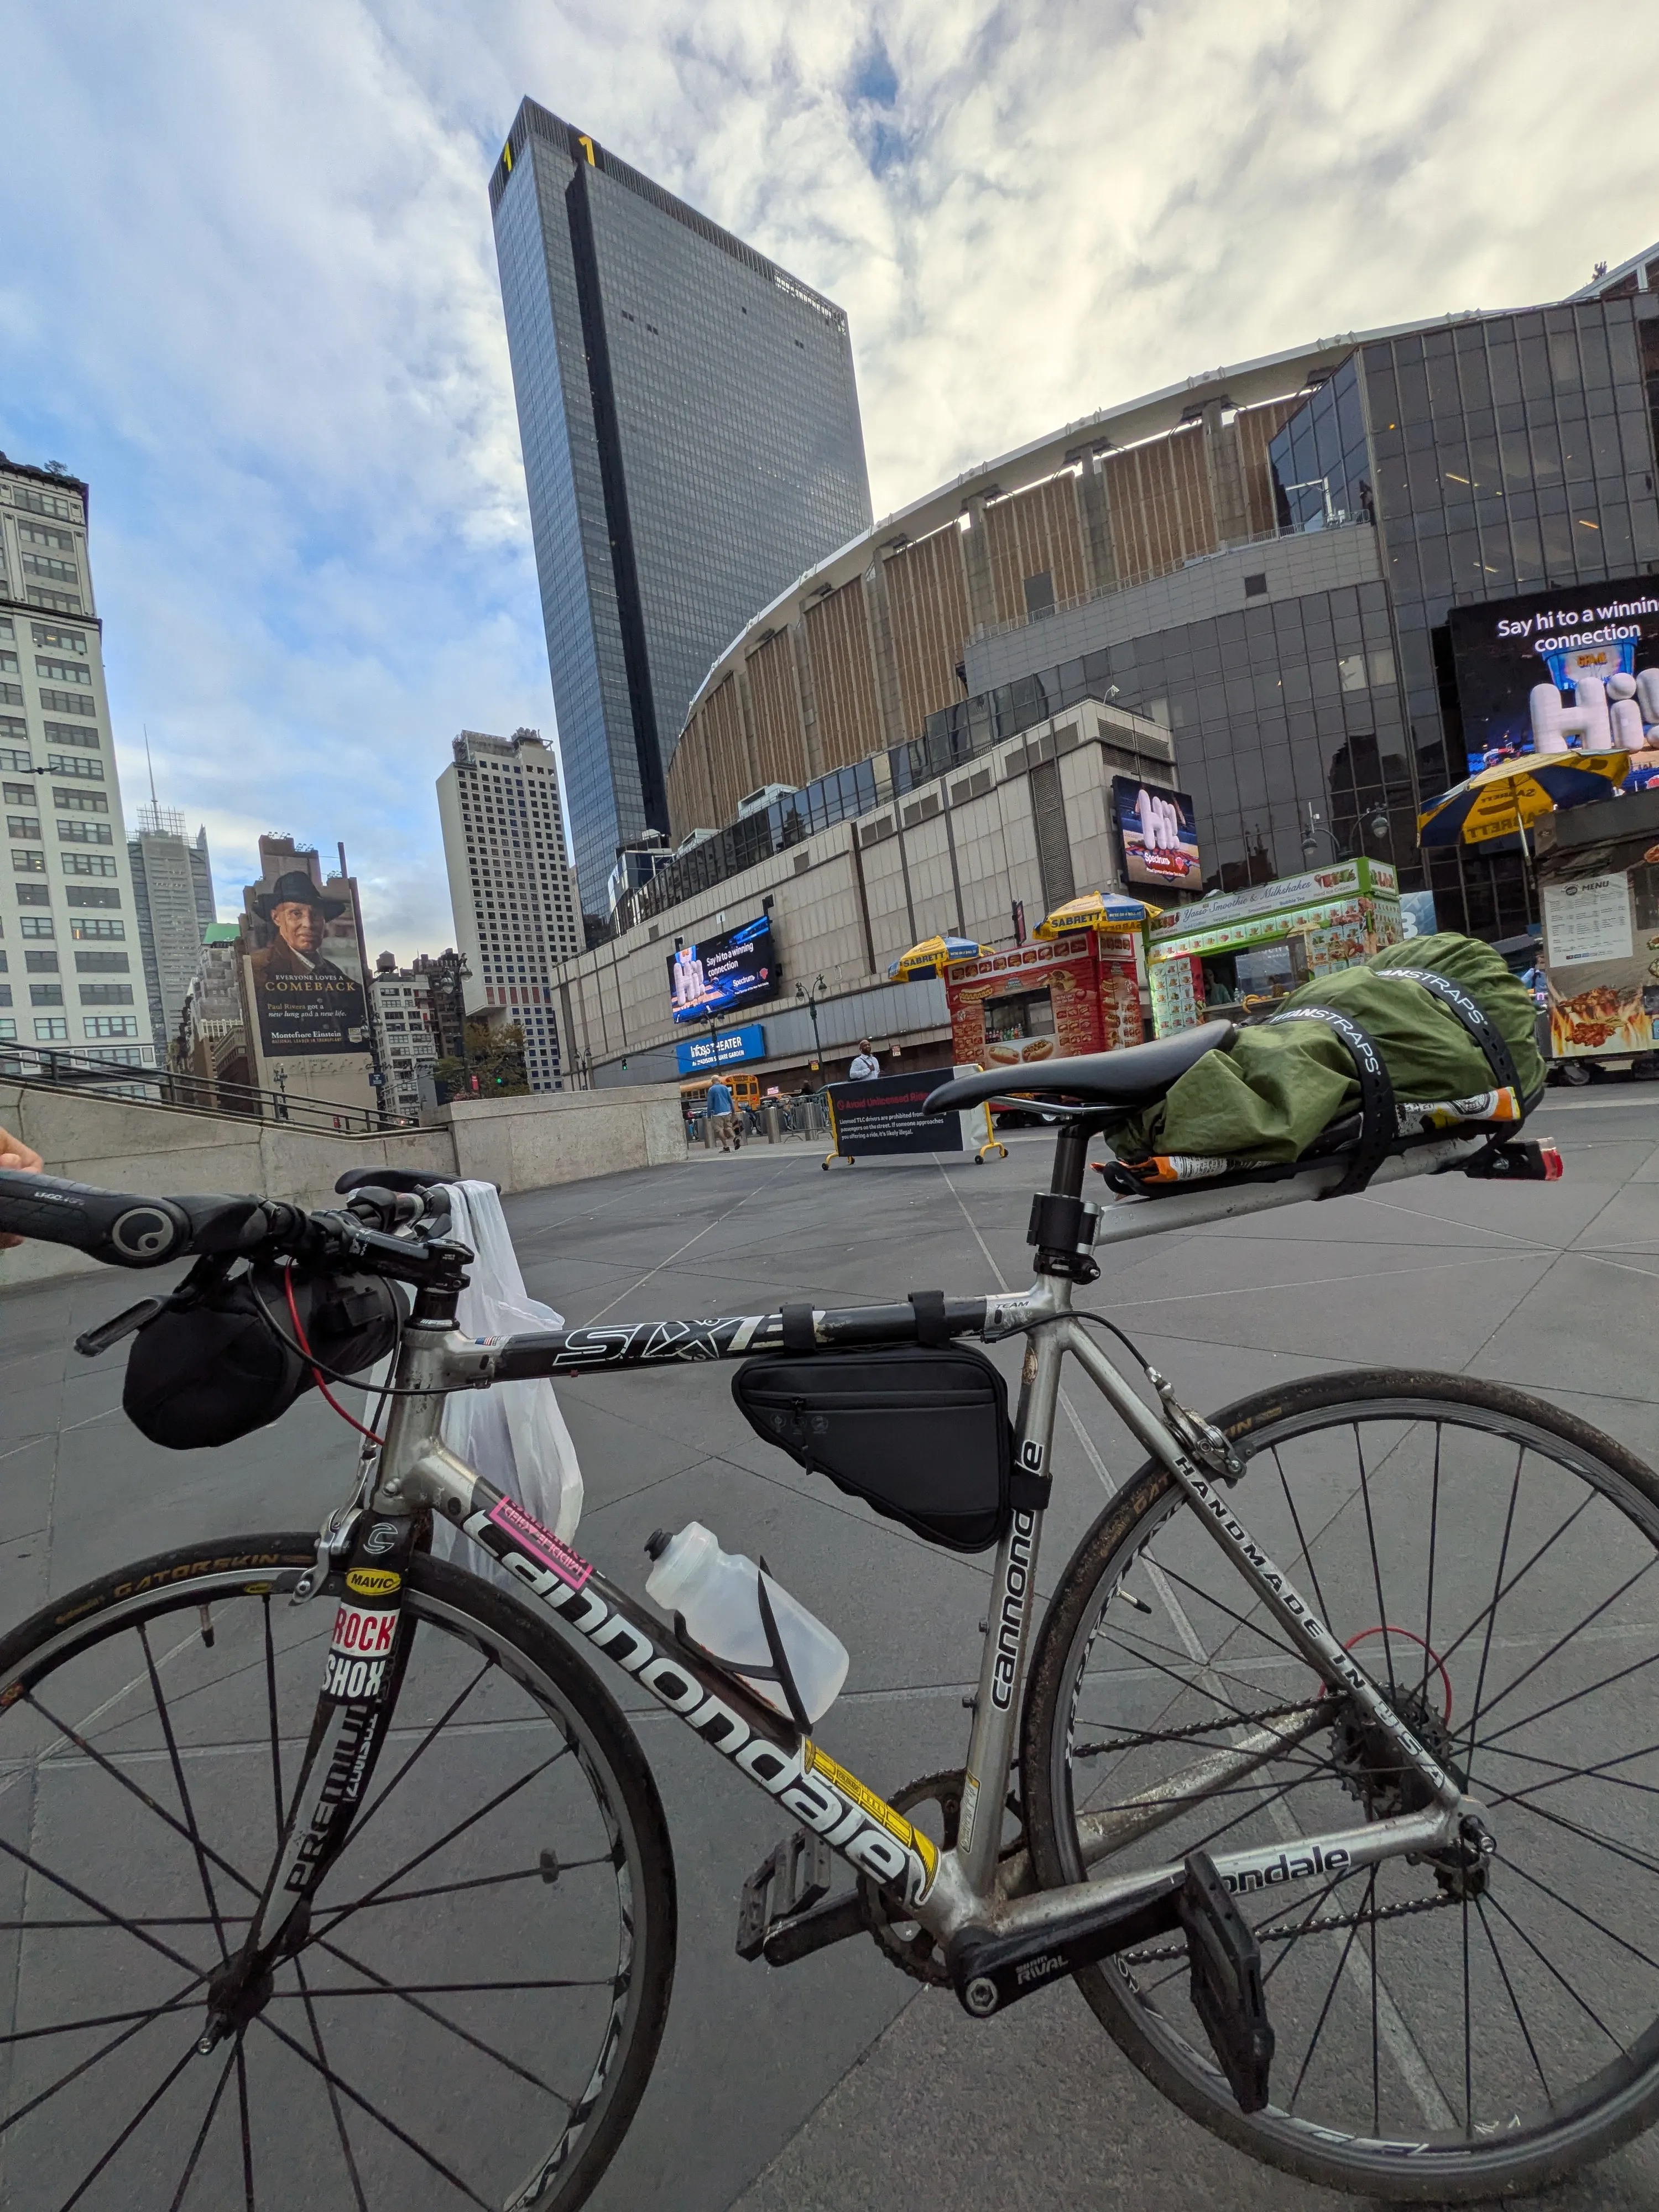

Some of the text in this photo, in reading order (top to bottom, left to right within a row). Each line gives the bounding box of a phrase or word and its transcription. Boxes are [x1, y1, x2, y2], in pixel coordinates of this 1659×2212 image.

[578, 136, 595, 168] 1
[1498, 596, 1659, 637] Say hi to a winnin
[1535, 623, 1641, 653] connection
[1144, 852, 1170, 865] Spectrum
[1582, 880, 1610, 891] MENU
[1183, 908, 1207, 922] Yasso
[1209, 895, 1248, 912] Smoothie
[1260, 880, 1312, 900] Milkshakes
[1051, 912, 1100, 929] SABRETT
[706, 957, 717, 967] Say
[716, 954, 722, 963] hi
[721, 952, 728, 962] to
[731, 942, 754, 957] winning
[903, 951, 945, 967] SABRETT
[708, 959, 739, 977] connection
[265, 981, 356, 992] COMEBACK
[733, 974, 755, 988] Spectrum
[1376, 969, 1488, 1025] ANSTRAPS
[690, 1043, 711, 1058] Infosys
[697, 1056, 714, 1066] MADISON
[714, 1054, 729, 1062] SUARE
[728, 1049, 745, 1059] GARDEN
[845, 1099, 866, 1109] Avoid
[867, 1093, 910, 1105] Unlicensed
[889, 1113, 912, 1121] prohibited
[840, 1125, 863, 1134] passengers
[996, 1301, 1030, 1309] TEAM
[113, 1553, 280, 1599] GATORSKIN
[351, 1573, 394, 1589] MAVIC
[990, 1439, 1045, 1713] cannonde
[1174, 1454, 1324, 1640] HANDMADE
[1329, 1654, 1367, 1692] IN
[332, 1606, 397, 1652] ROCK
[321, 1653, 387, 1698] SHOX
[462, 1509, 908, 1885] cannondale
[1220, 1845, 1350, 1893] ondale
[1018, 1955, 1069, 1985] RIVAL
